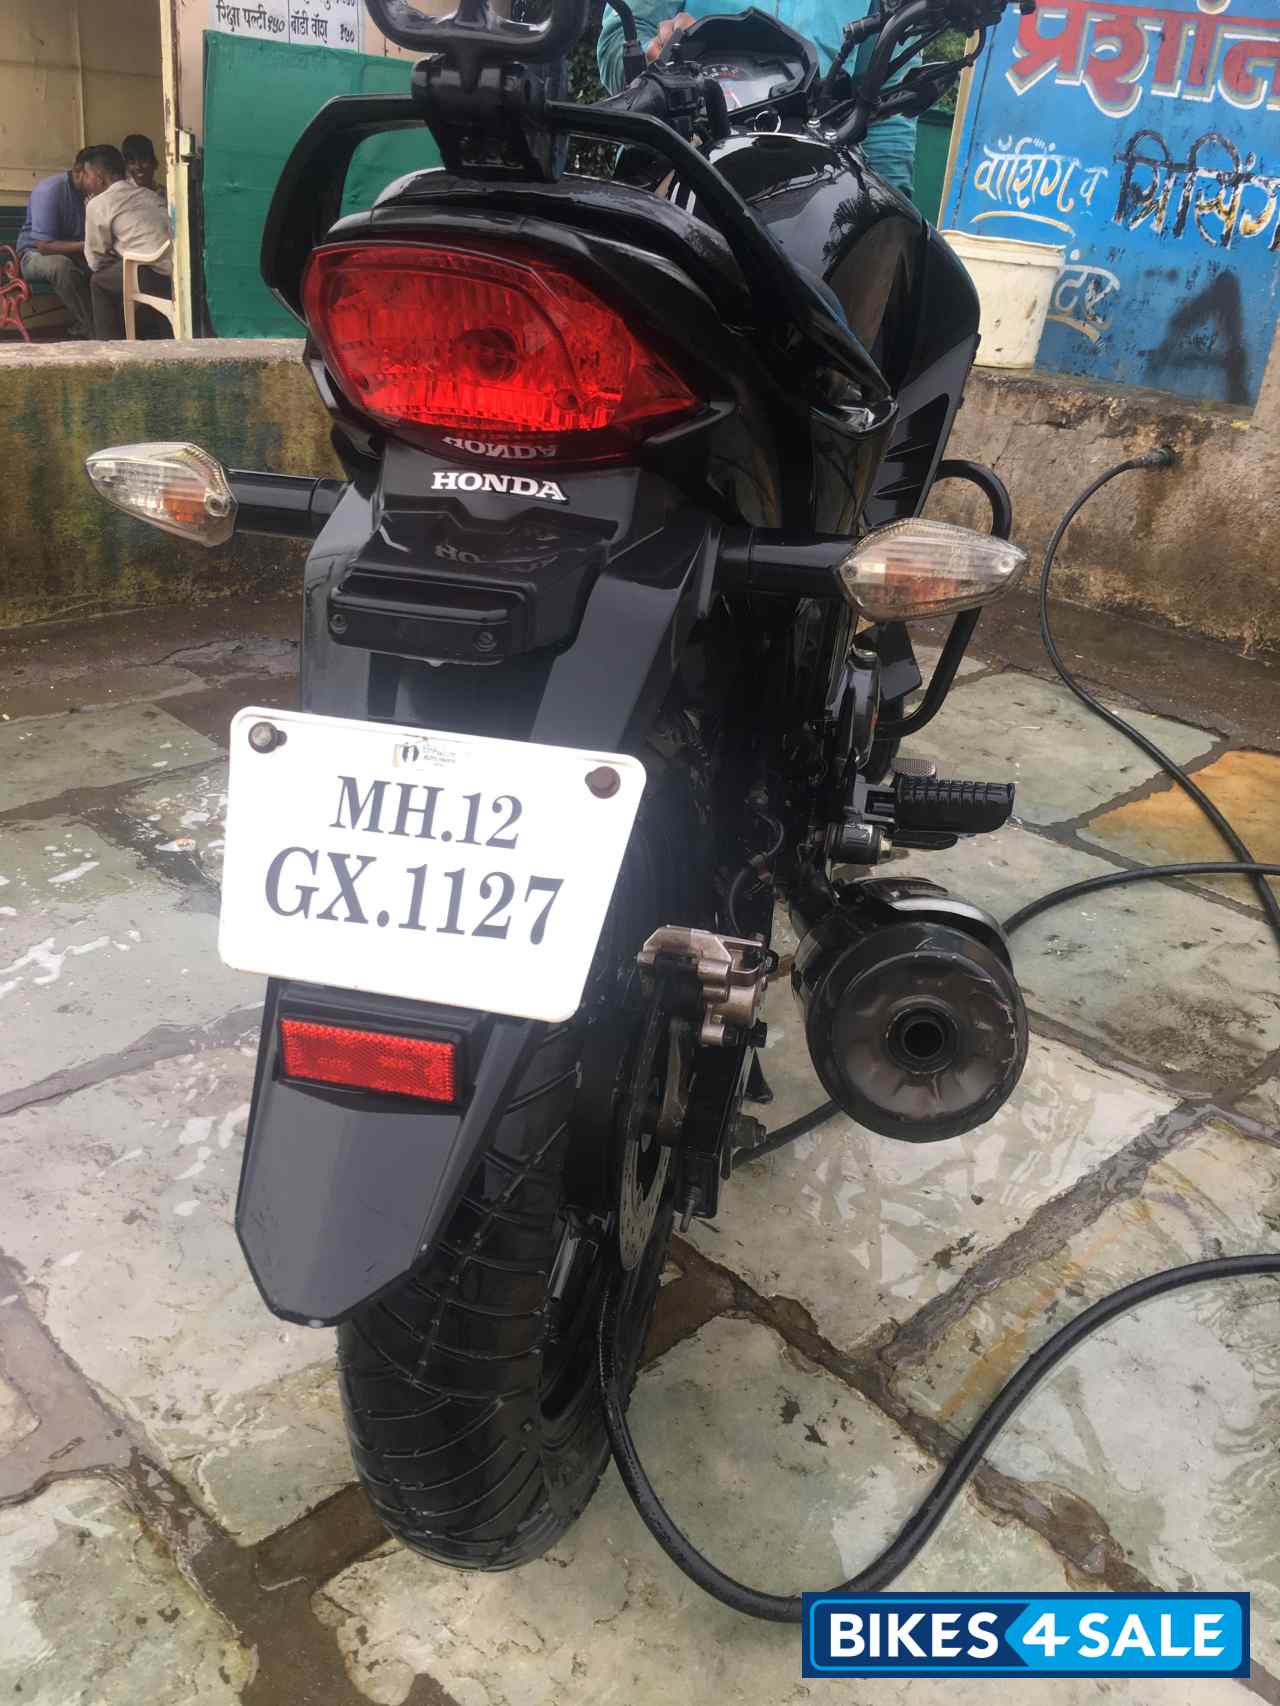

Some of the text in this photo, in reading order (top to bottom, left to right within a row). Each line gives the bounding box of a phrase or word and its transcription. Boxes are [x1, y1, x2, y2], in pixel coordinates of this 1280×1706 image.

[431, 471, 568, 502] HONDA
[329, 775, 523, 850] MH.12
[264, 846, 565, 946] GX.1127
